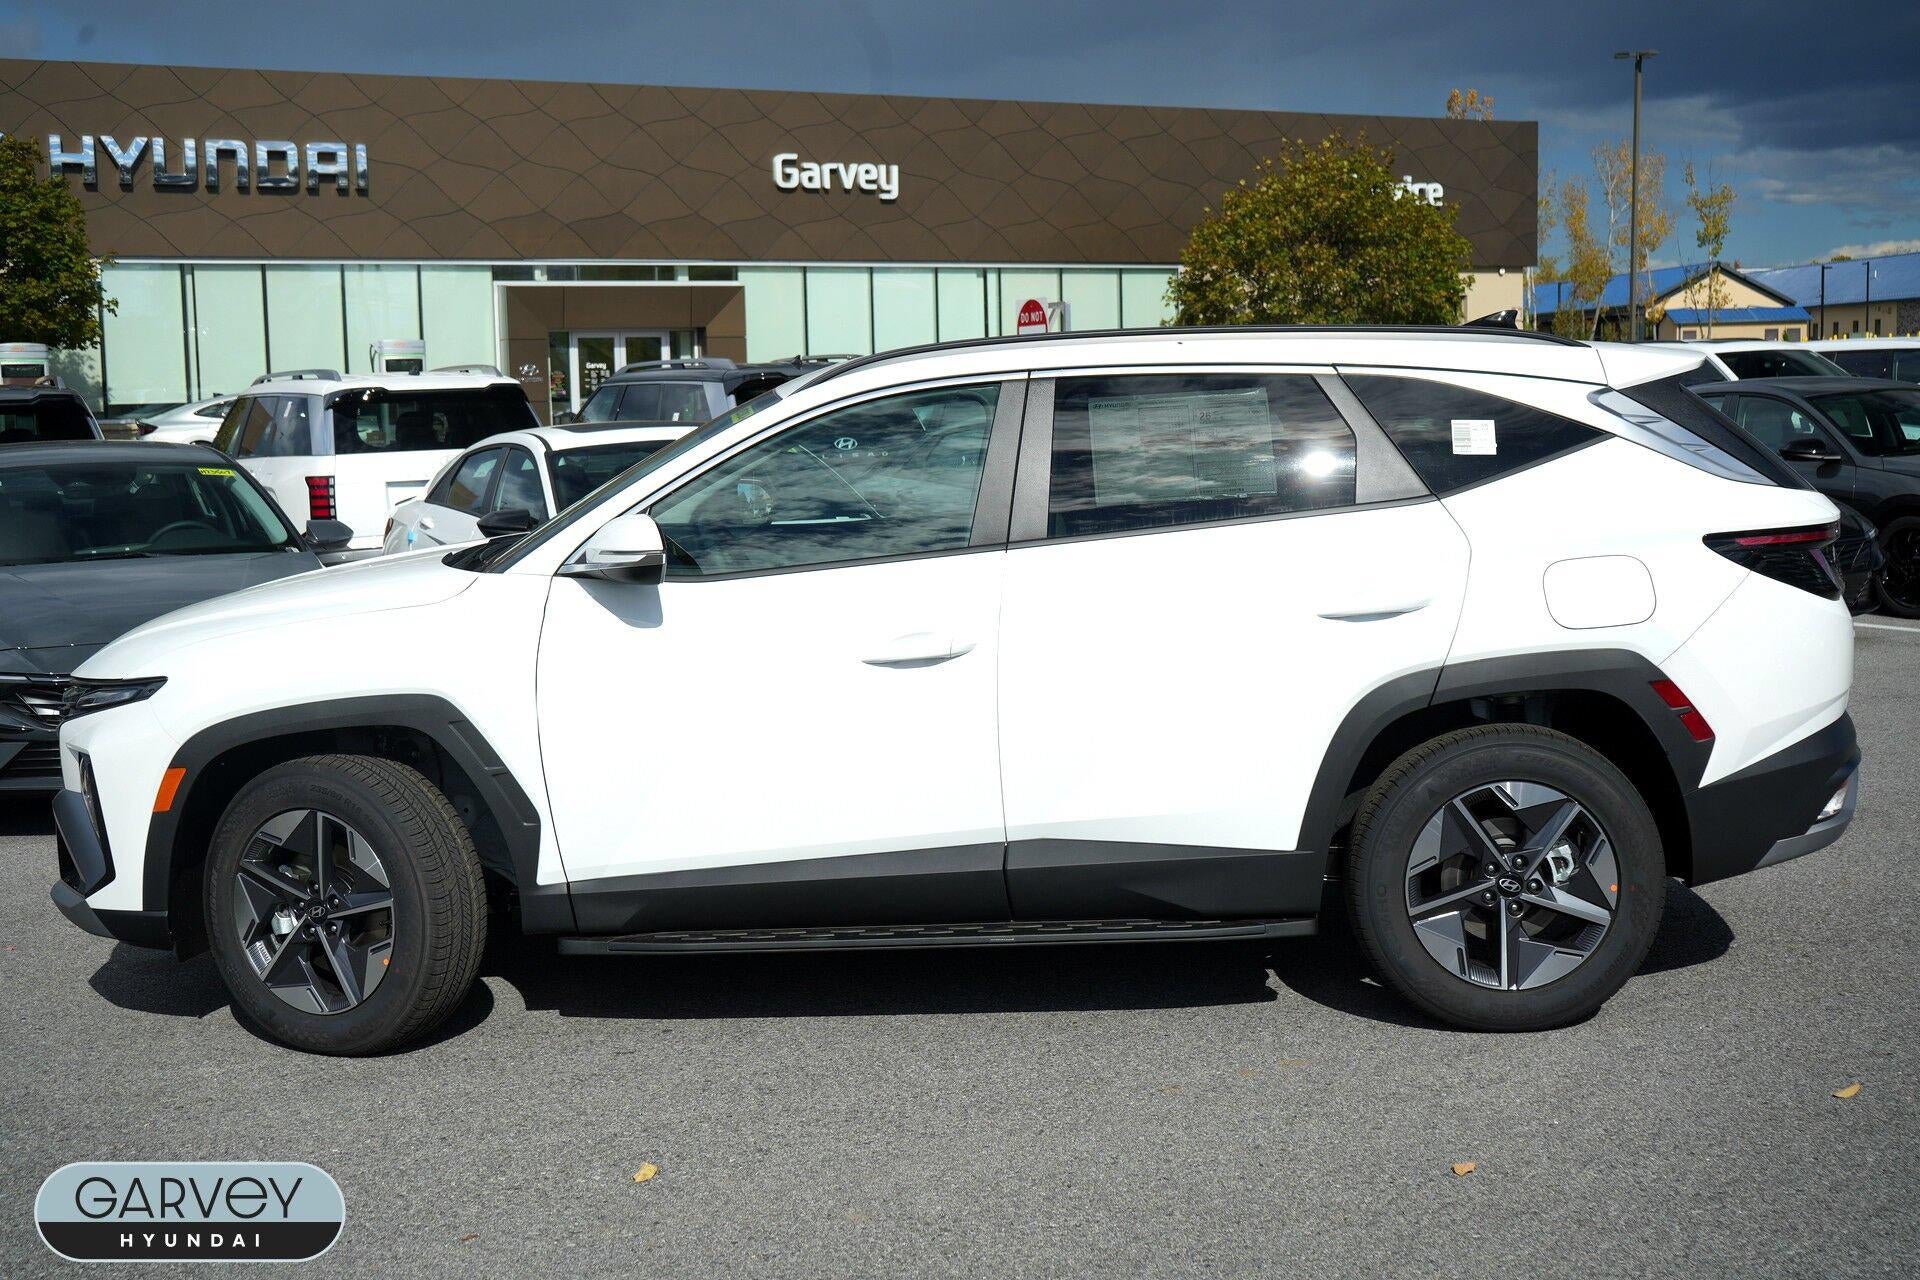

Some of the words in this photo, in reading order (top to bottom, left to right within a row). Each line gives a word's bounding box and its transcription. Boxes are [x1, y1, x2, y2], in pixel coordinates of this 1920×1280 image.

[49, 134, 368, 192] HYUNDAI
[772, 153, 900, 200] Garvey
[1020, 312, 1030, 323] DO
[1030, 311, 1043, 322] NOT
